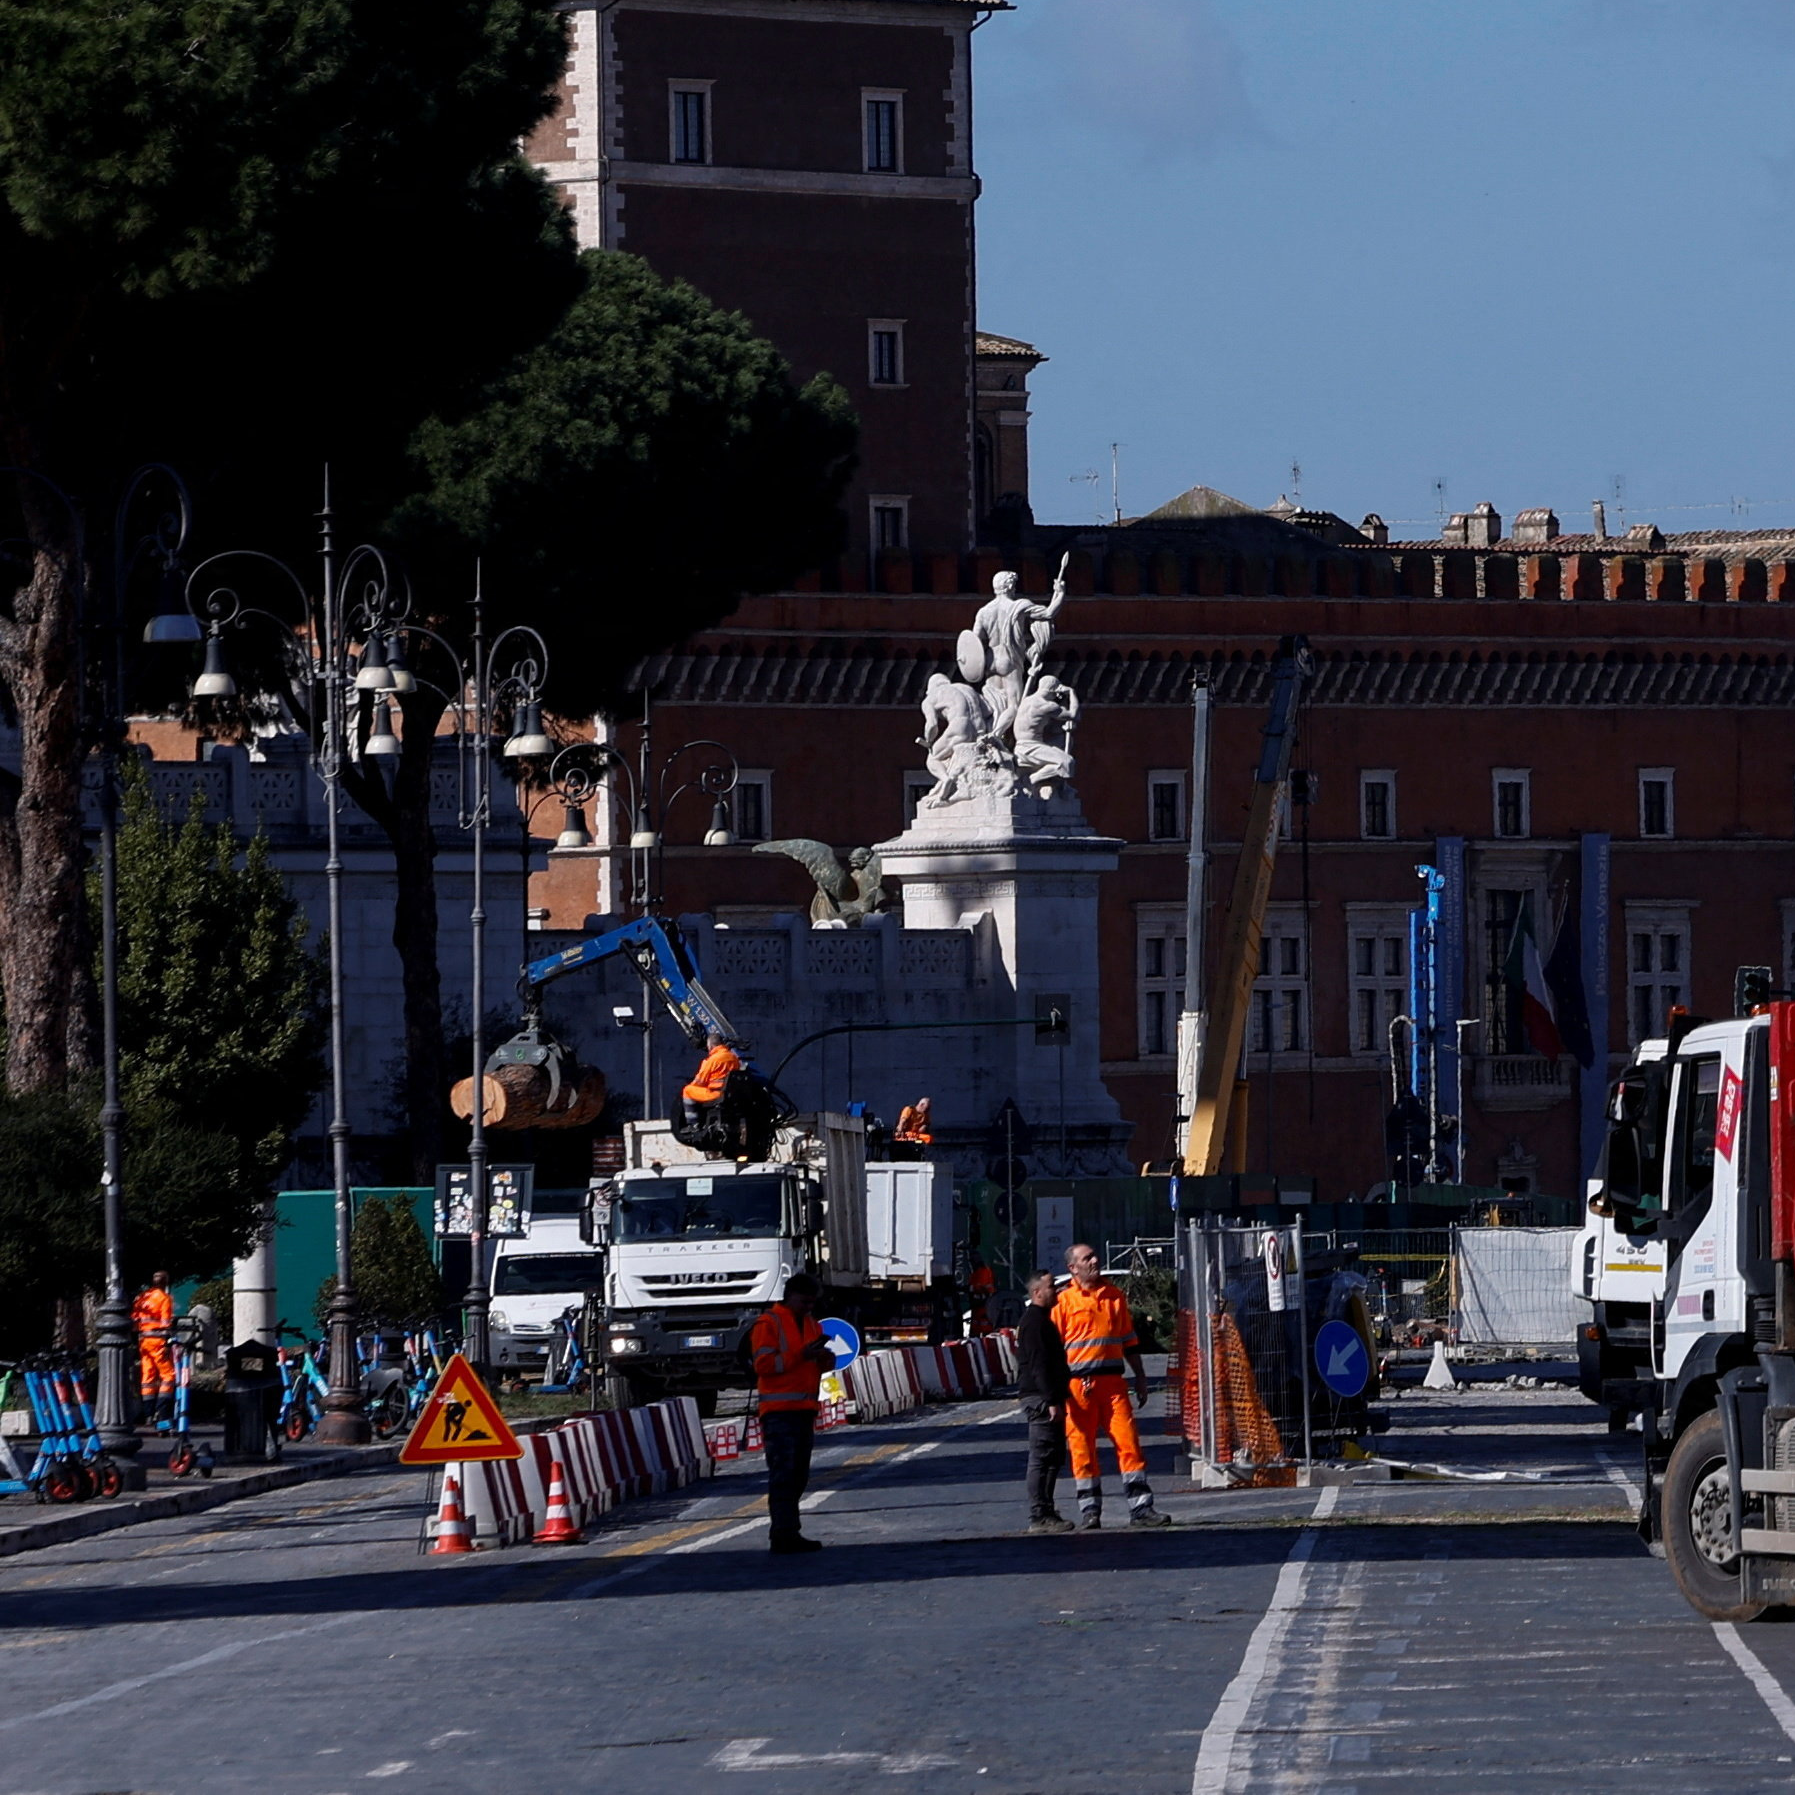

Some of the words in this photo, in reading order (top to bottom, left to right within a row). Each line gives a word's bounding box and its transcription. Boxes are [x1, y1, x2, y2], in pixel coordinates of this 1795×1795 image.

[1595, 844, 1607, 918] Venezia
[1595, 923, 1607, 996] Palazzo
[647, 1243, 751, 1254] TRAKKER
[670, 1272, 728, 1285] IVECO
